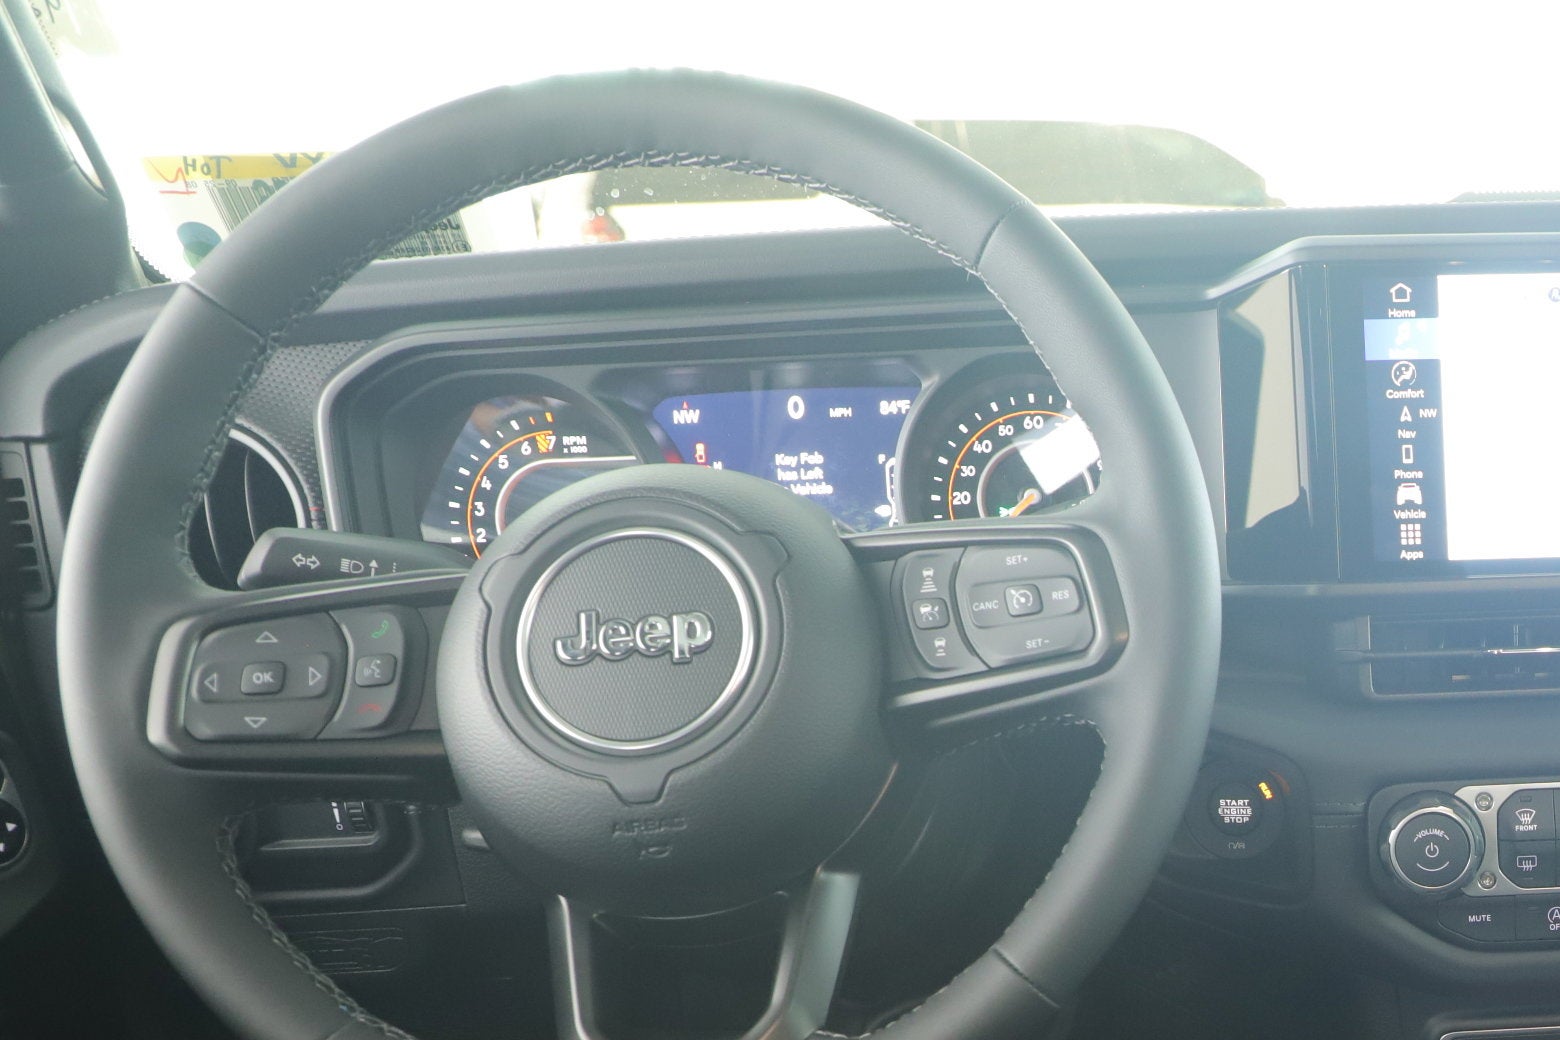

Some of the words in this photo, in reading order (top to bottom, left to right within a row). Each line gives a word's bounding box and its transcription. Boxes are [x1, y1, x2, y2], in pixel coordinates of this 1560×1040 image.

[1387, 308, 1416, 318] Home
[1385, 388, 1425, 399] Comfort
[787, 395, 805, 420] 0
[829, 407, 852, 418] MPH
[1419, 408, 1438, 418] NW
[673, 409, 700, 424] NW
[1023, 416, 1044, 429] 60
[998, 425, 1014, 436] 50
[1397, 429, 1417, 439] Nav
[546, 435, 556, 450] 7
[562, 435, 587, 446] RPM
[973, 440, 992, 453] 40
[521, 441, 532, 456] 6
[498, 455, 509, 469] 5
[960, 466, 976, 477] 30
[1394, 469, 1424, 480] Phone
[481, 475, 492, 491] 4
[952, 491, 971, 504] 20
[474, 501, 485, 516] 3
[1393, 509, 1427, 520] Vehicle
[476, 528, 487, 543] 2
[1400, 550, 1424, 560] Apps
[1051, 590, 1070, 600] RES
[972, 600, 1000, 612] CANC
[554, 609, 714, 666] Jeep
[252, 672, 275, 685] OK
[1224, 816, 1250, 824] STOP
[1416, 827, 1445, 840] VOLUME
[1515, 824, 1538, 832] FRONT
[1468, 914, 1492, 923] MUTE
